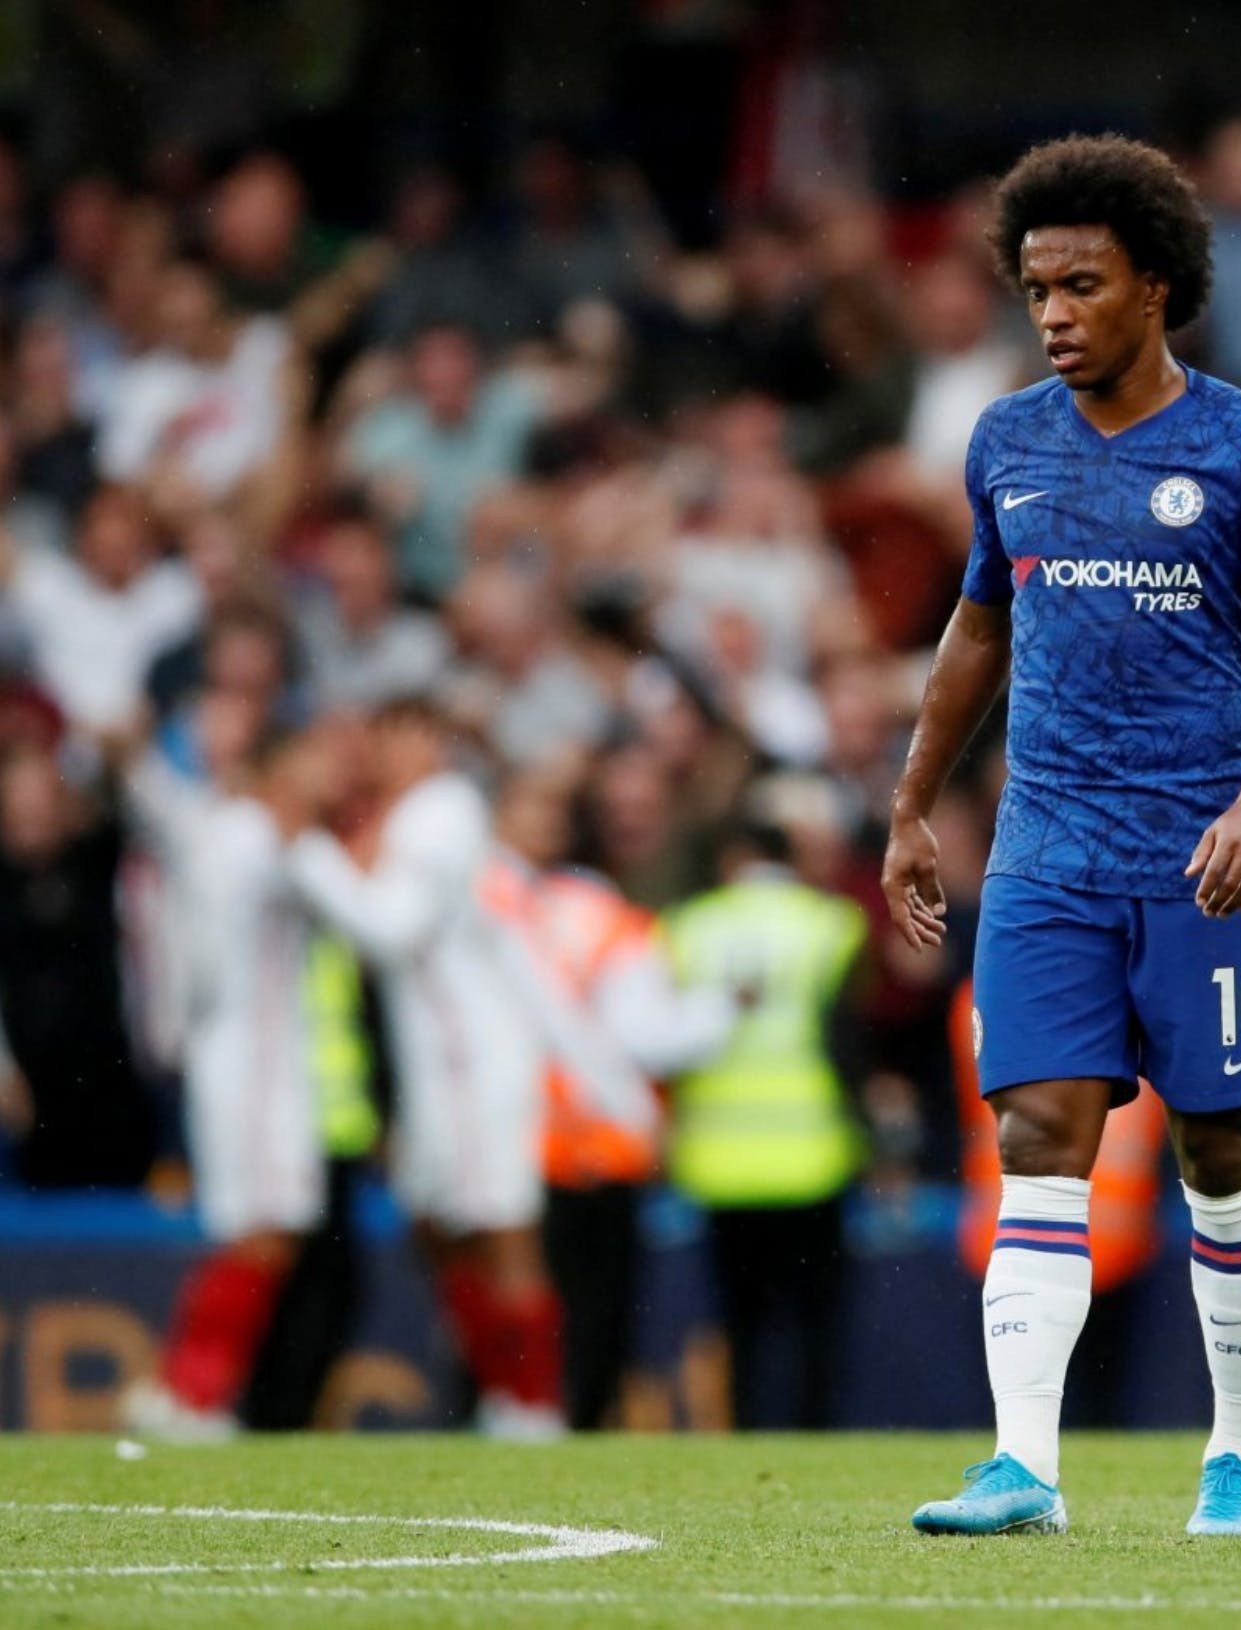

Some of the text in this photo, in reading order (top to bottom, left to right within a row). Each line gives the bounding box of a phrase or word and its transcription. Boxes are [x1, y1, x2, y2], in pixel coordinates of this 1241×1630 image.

[1041, 560, 1202, 588] YOKOHAMA
[1133, 592, 1202, 612] TYRES
[991, 1320, 1028, 1338] CFC
